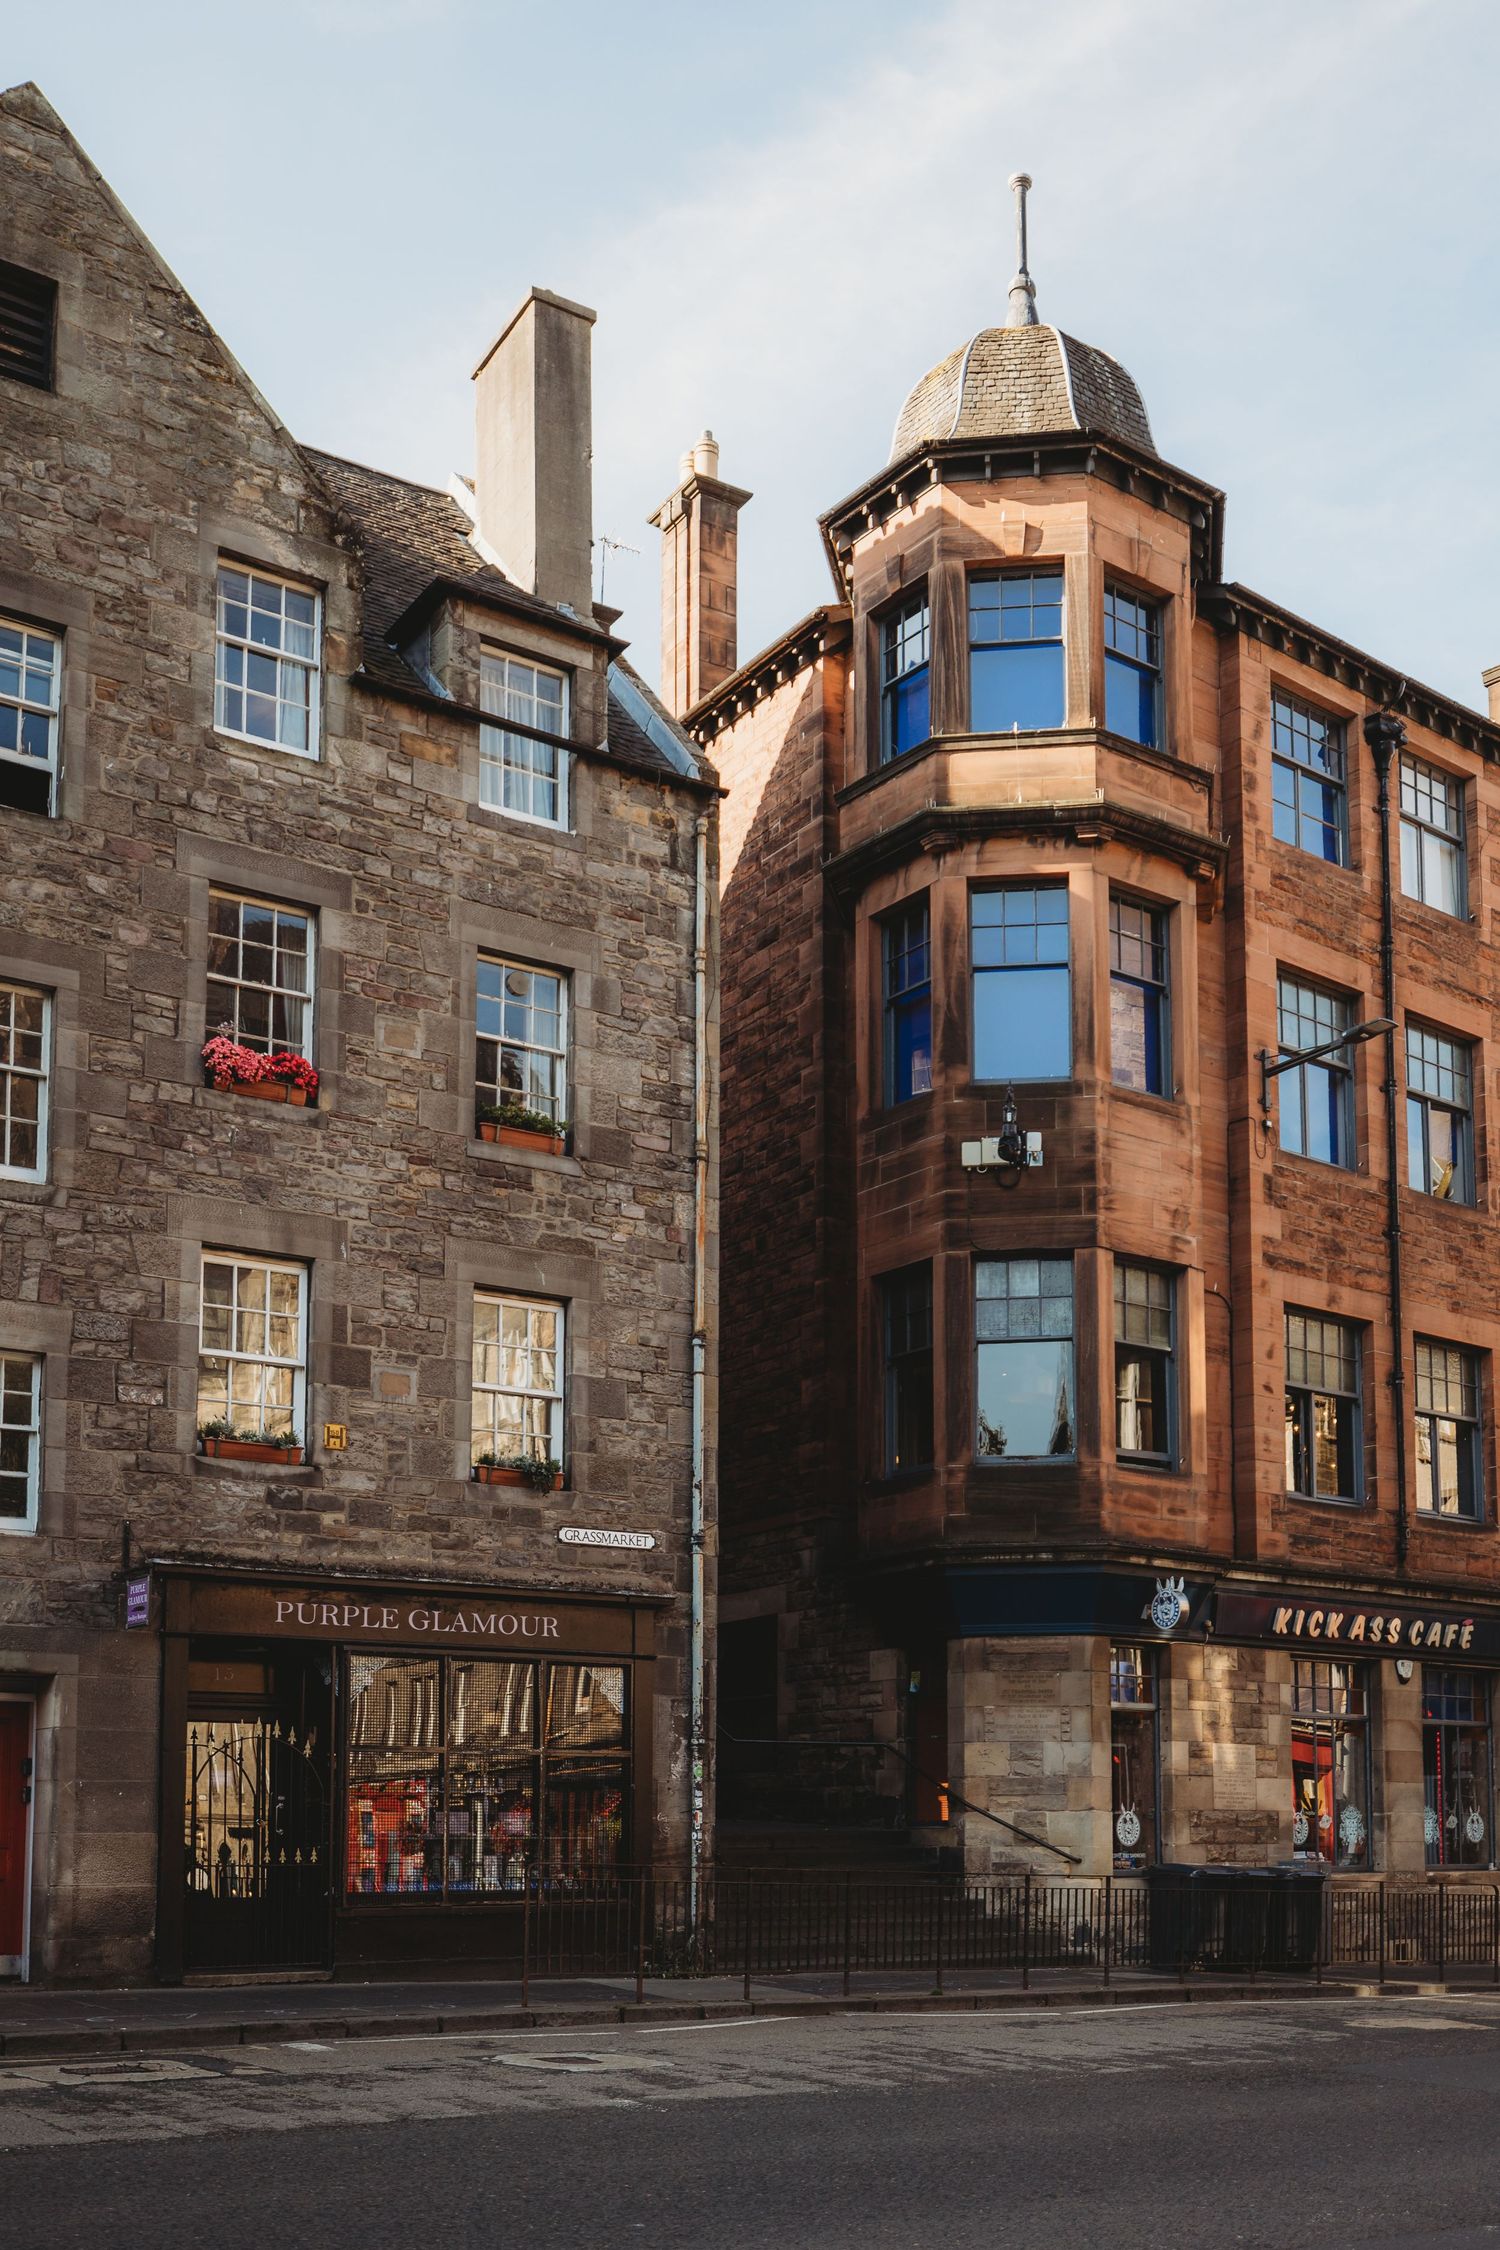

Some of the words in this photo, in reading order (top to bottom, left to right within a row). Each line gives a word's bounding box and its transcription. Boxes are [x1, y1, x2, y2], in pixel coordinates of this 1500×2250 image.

[564, 1529, 650, 1547] GRASSMARKET
[274, 1601, 400, 1629] PURPLE
[408, 1609, 560, 1637] GLAMOUR
[1273, 1607, 1344, 1638] KICK
[1348, 1614, 1401, 1644] ASS
[1408, 1618, 1474, 1649] CAFÉ
